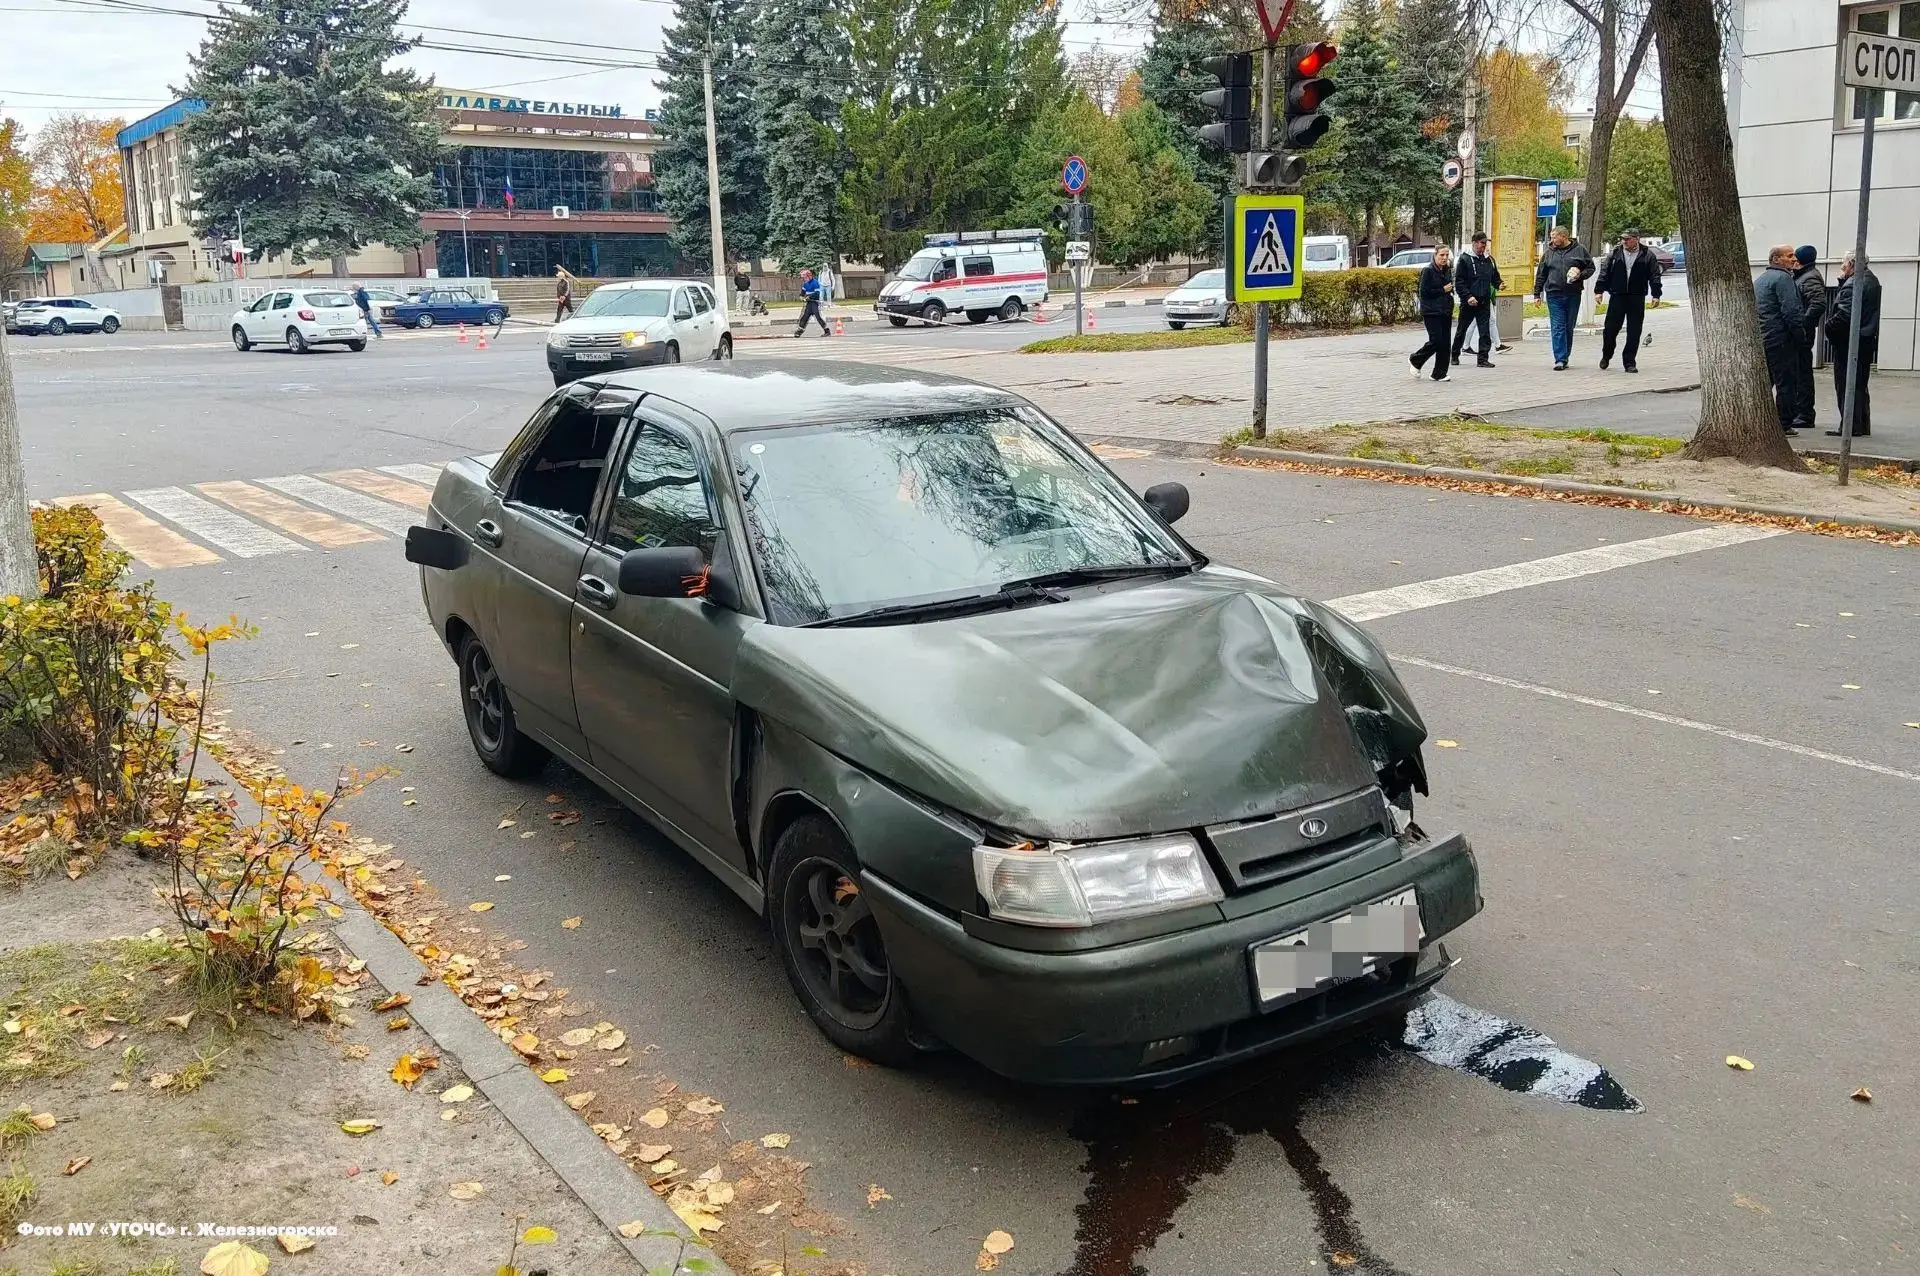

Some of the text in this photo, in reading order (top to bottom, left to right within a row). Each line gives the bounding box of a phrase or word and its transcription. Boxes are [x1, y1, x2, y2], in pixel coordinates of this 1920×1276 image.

[1855, 42, 1915, 82] СТОП
[442, 94, 621, 118] ПЛАВАТЕЛЬНЫЙ
[1461, 138, 1470, 150] 40
